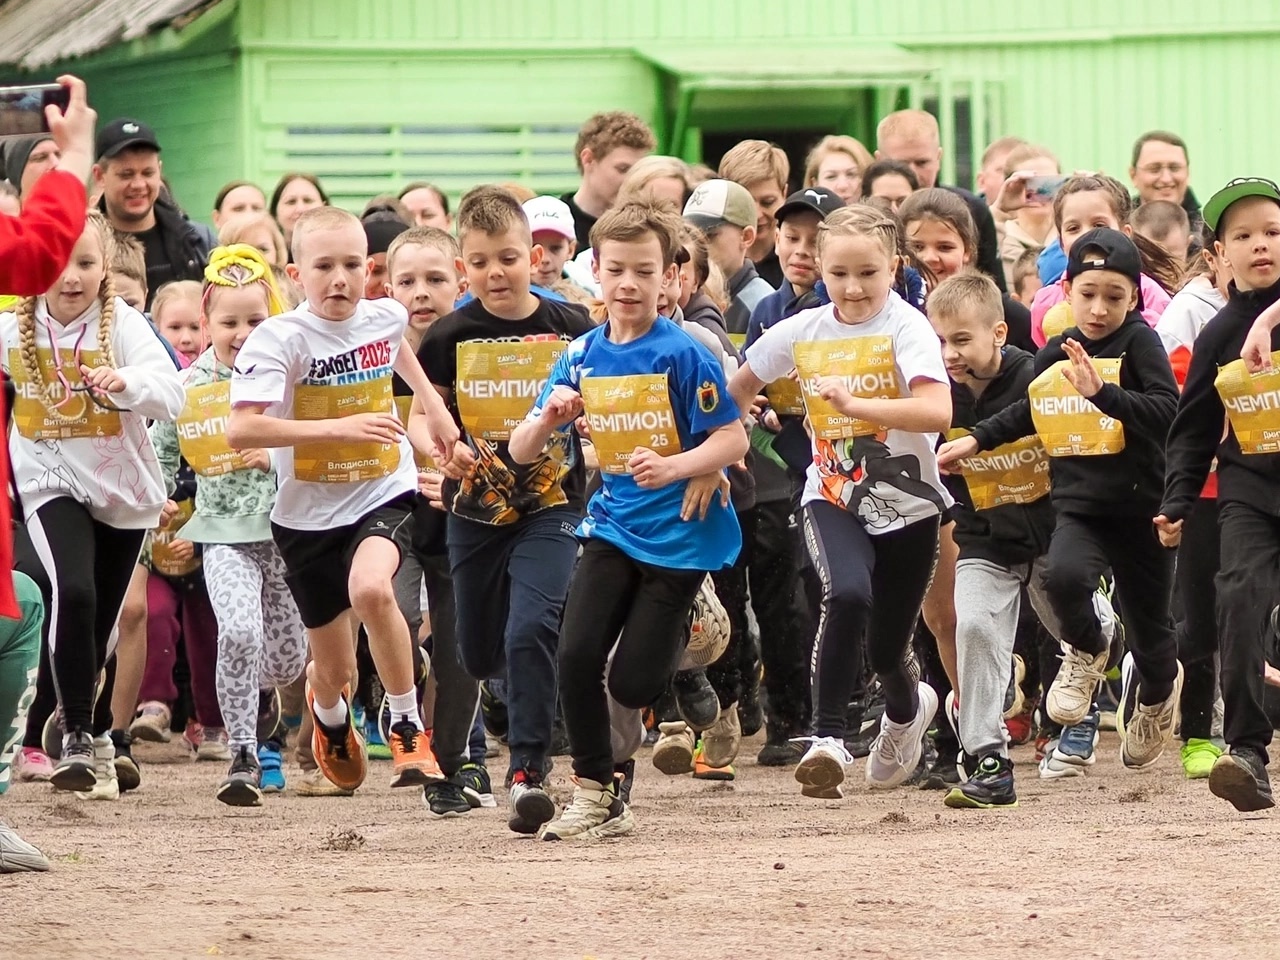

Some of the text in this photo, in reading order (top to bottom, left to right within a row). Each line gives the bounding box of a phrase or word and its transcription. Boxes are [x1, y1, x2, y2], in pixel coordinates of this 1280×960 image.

[872, 344, 888, 353] RUN
[308, 348, 358, 378] #ЗАБЕГ
[357, 340, 391, 369] 2025
[1102, 367, 1117, 375] RUN
[650, 383, 665, 391] RUN
[586, 410, 673, 433] ЧЕМПИОН
[1099, 416, 1114, 430] 92
[650, 433, 669, 447] 25
[327, 458, 380, 470] Владислав
[1033, 460, 1049, 473] 42
